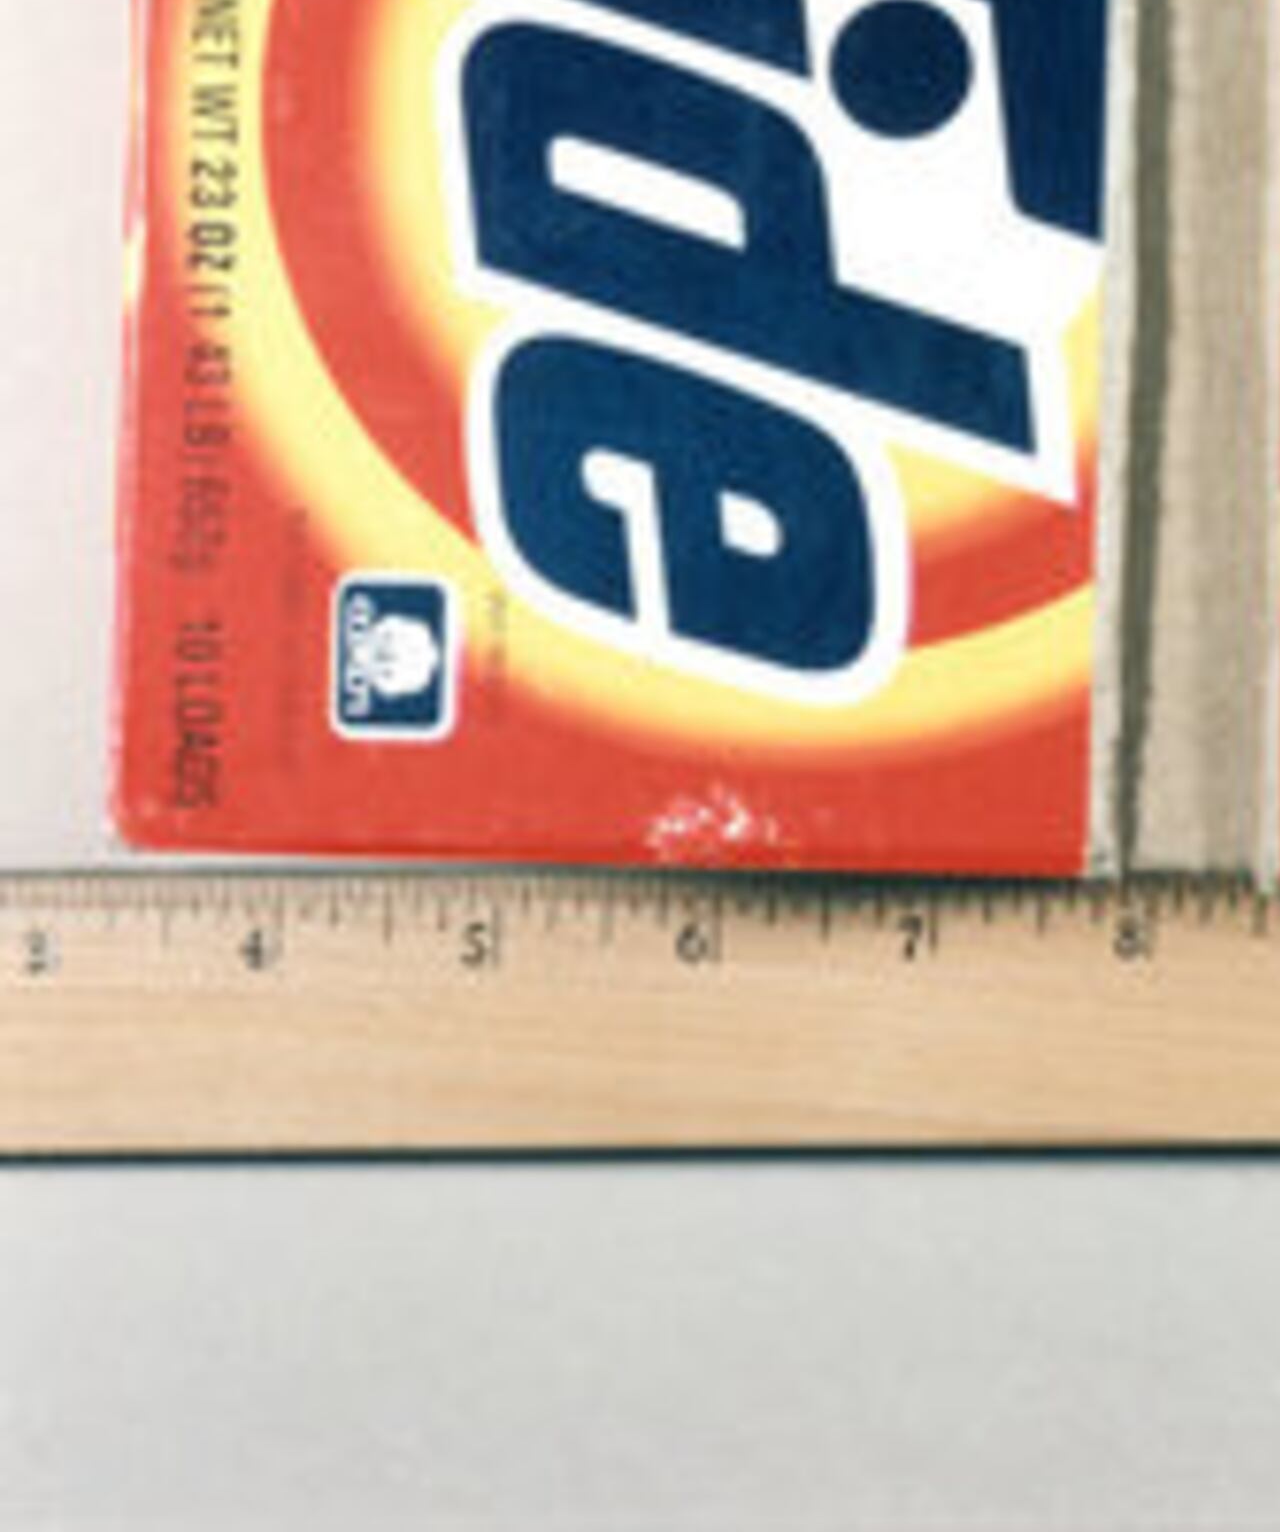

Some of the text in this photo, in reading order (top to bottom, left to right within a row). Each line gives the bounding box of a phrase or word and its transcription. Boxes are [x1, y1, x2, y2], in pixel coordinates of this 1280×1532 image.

[190, 84, 239, 146] WT
[188, 158, 239, 209] 23
[185, 221, 239, 273] OZ
[177, 621, 224, 662] 10
[174, 674, 224, 809] LOADS
[239, 927, 265, 970] 4
[460, 922, 488, 966] 5
[675, 922, 707, 964] 6
[899, 914, 922, 960] 7
[1113, 916, 1144, 958] 8
